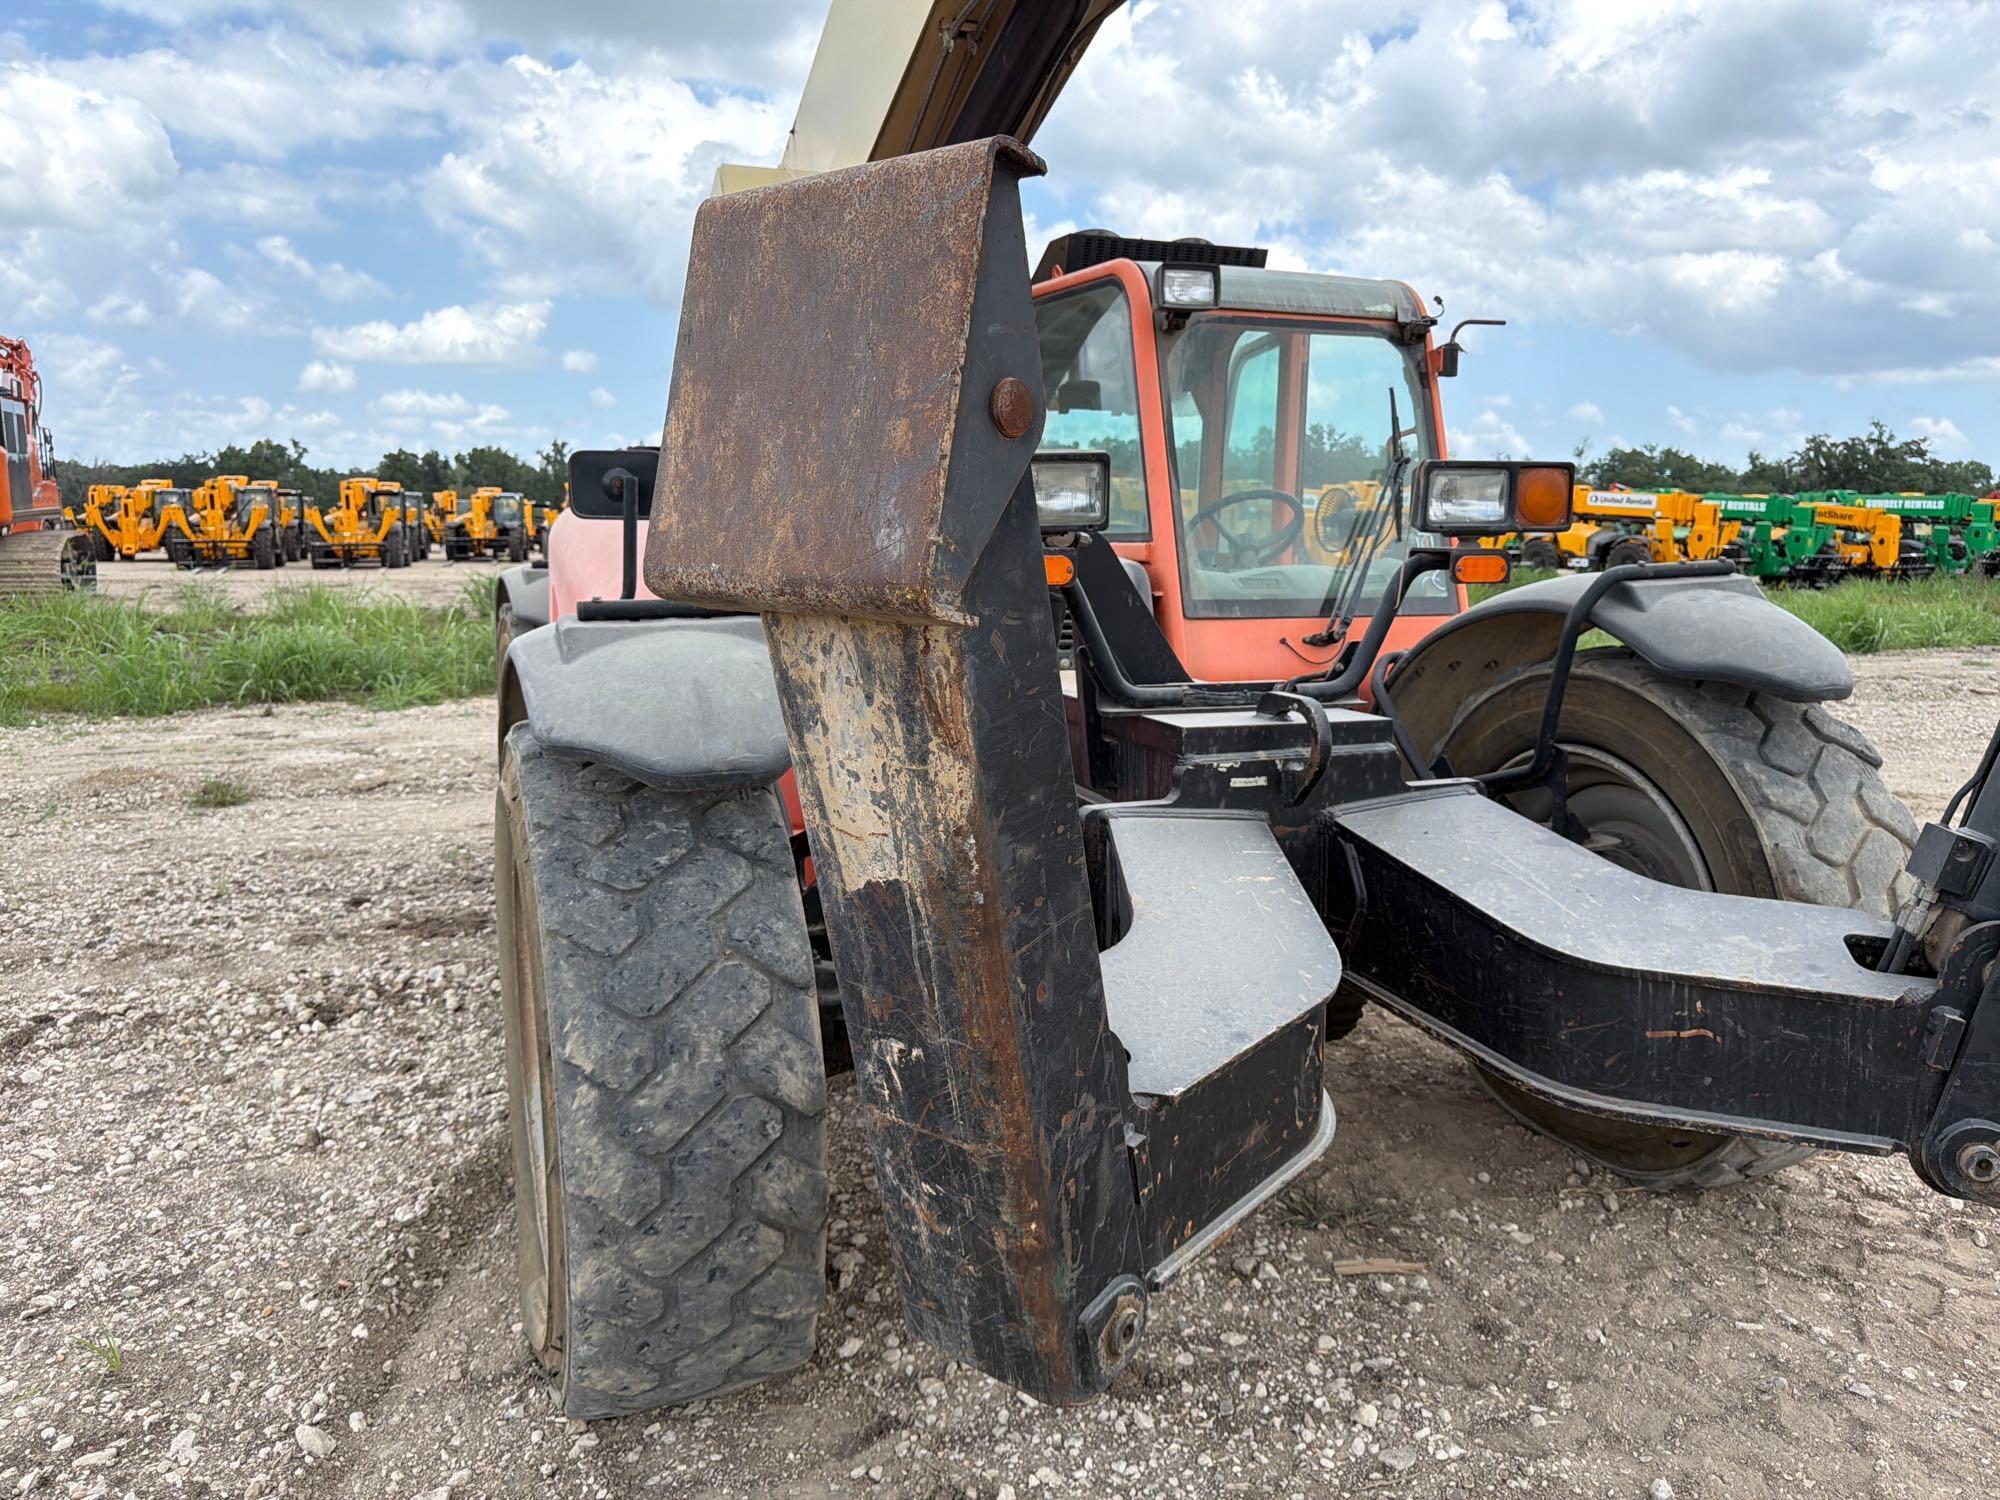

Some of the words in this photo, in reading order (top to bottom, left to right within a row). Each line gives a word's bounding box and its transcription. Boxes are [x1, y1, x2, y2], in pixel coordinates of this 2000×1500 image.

[1599, 496, 1625, 504] United
[1625, 497, 1654, 505] Rentals
[1866, 499, 1903, 508] SUNBELT
[1904, 499, 1943, 509] RENTALS
[1727, 501, 1766, 512] RENTALS
